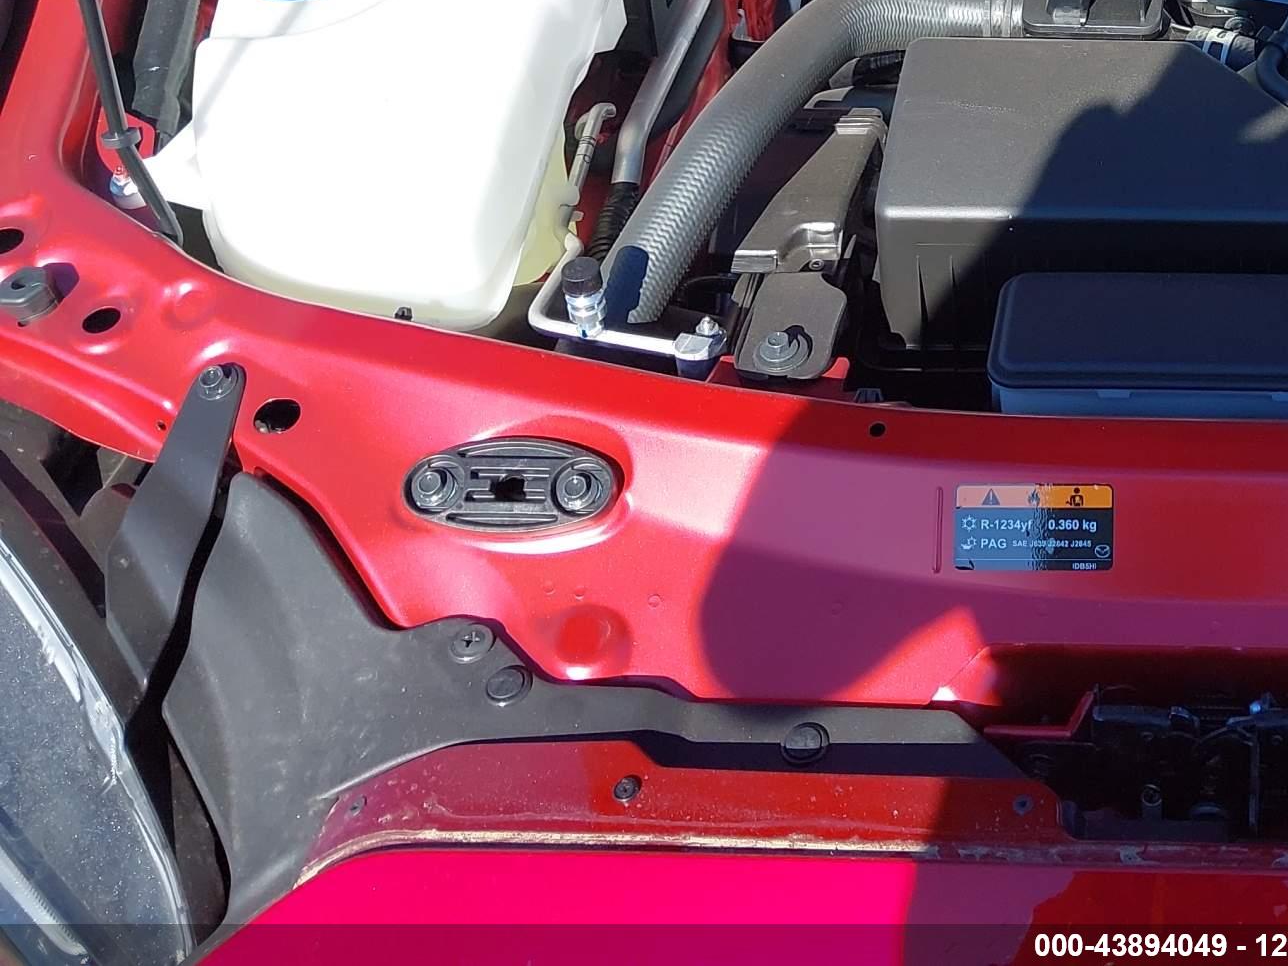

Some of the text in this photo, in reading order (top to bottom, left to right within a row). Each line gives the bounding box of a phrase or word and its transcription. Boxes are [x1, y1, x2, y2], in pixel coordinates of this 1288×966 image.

[980, 519, 1097, 533] R-1234yf 0.360 kg
[980, 538, 1007, 549] PAG
